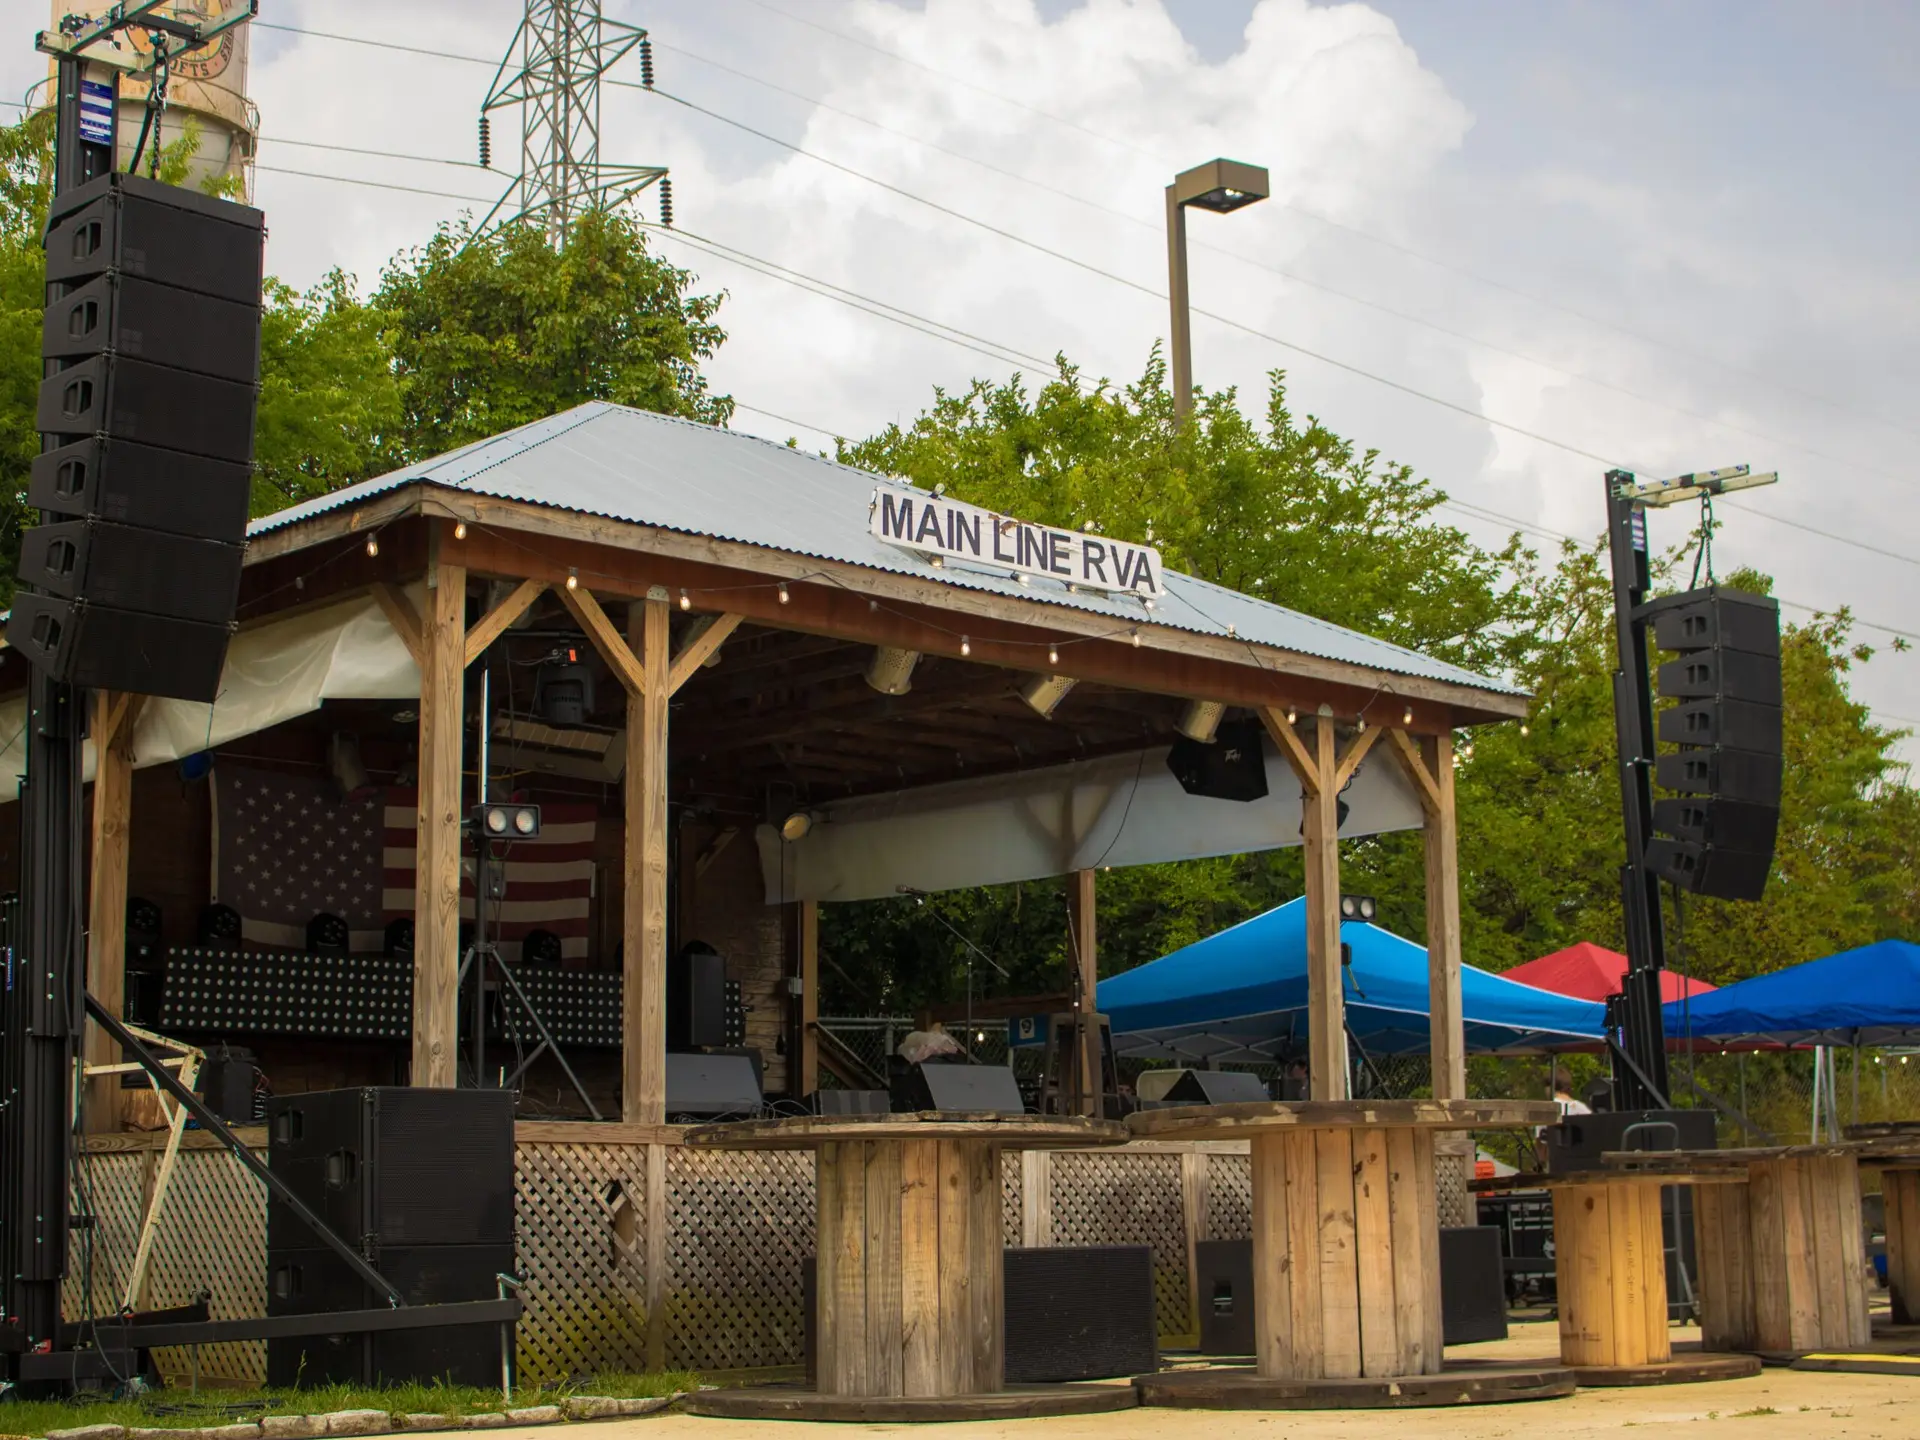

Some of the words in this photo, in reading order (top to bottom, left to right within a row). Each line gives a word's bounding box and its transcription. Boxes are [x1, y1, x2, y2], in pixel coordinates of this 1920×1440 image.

[171, 60, 209, 76] FTS
[882, 493, 980, 556] MAIN
[993, 517, 1071, 576] LINE
[1082, 539, 1157, 593] RVA
